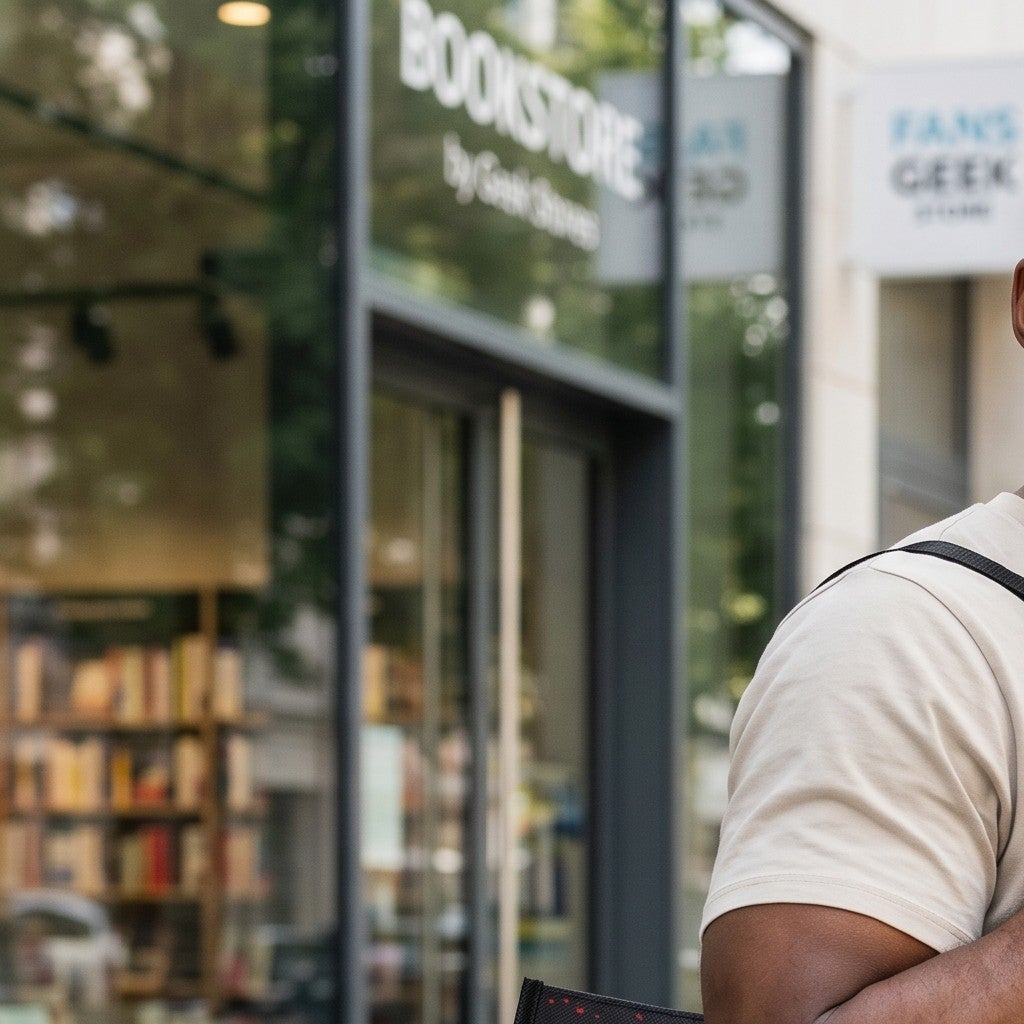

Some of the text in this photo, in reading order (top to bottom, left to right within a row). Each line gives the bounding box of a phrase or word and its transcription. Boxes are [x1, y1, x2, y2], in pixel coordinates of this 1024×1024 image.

[401, 0, 643, 198] BOOKSTORE
[889, 105, 1018, 146] FANS
[890, 155, 1018, 197] GEEK
